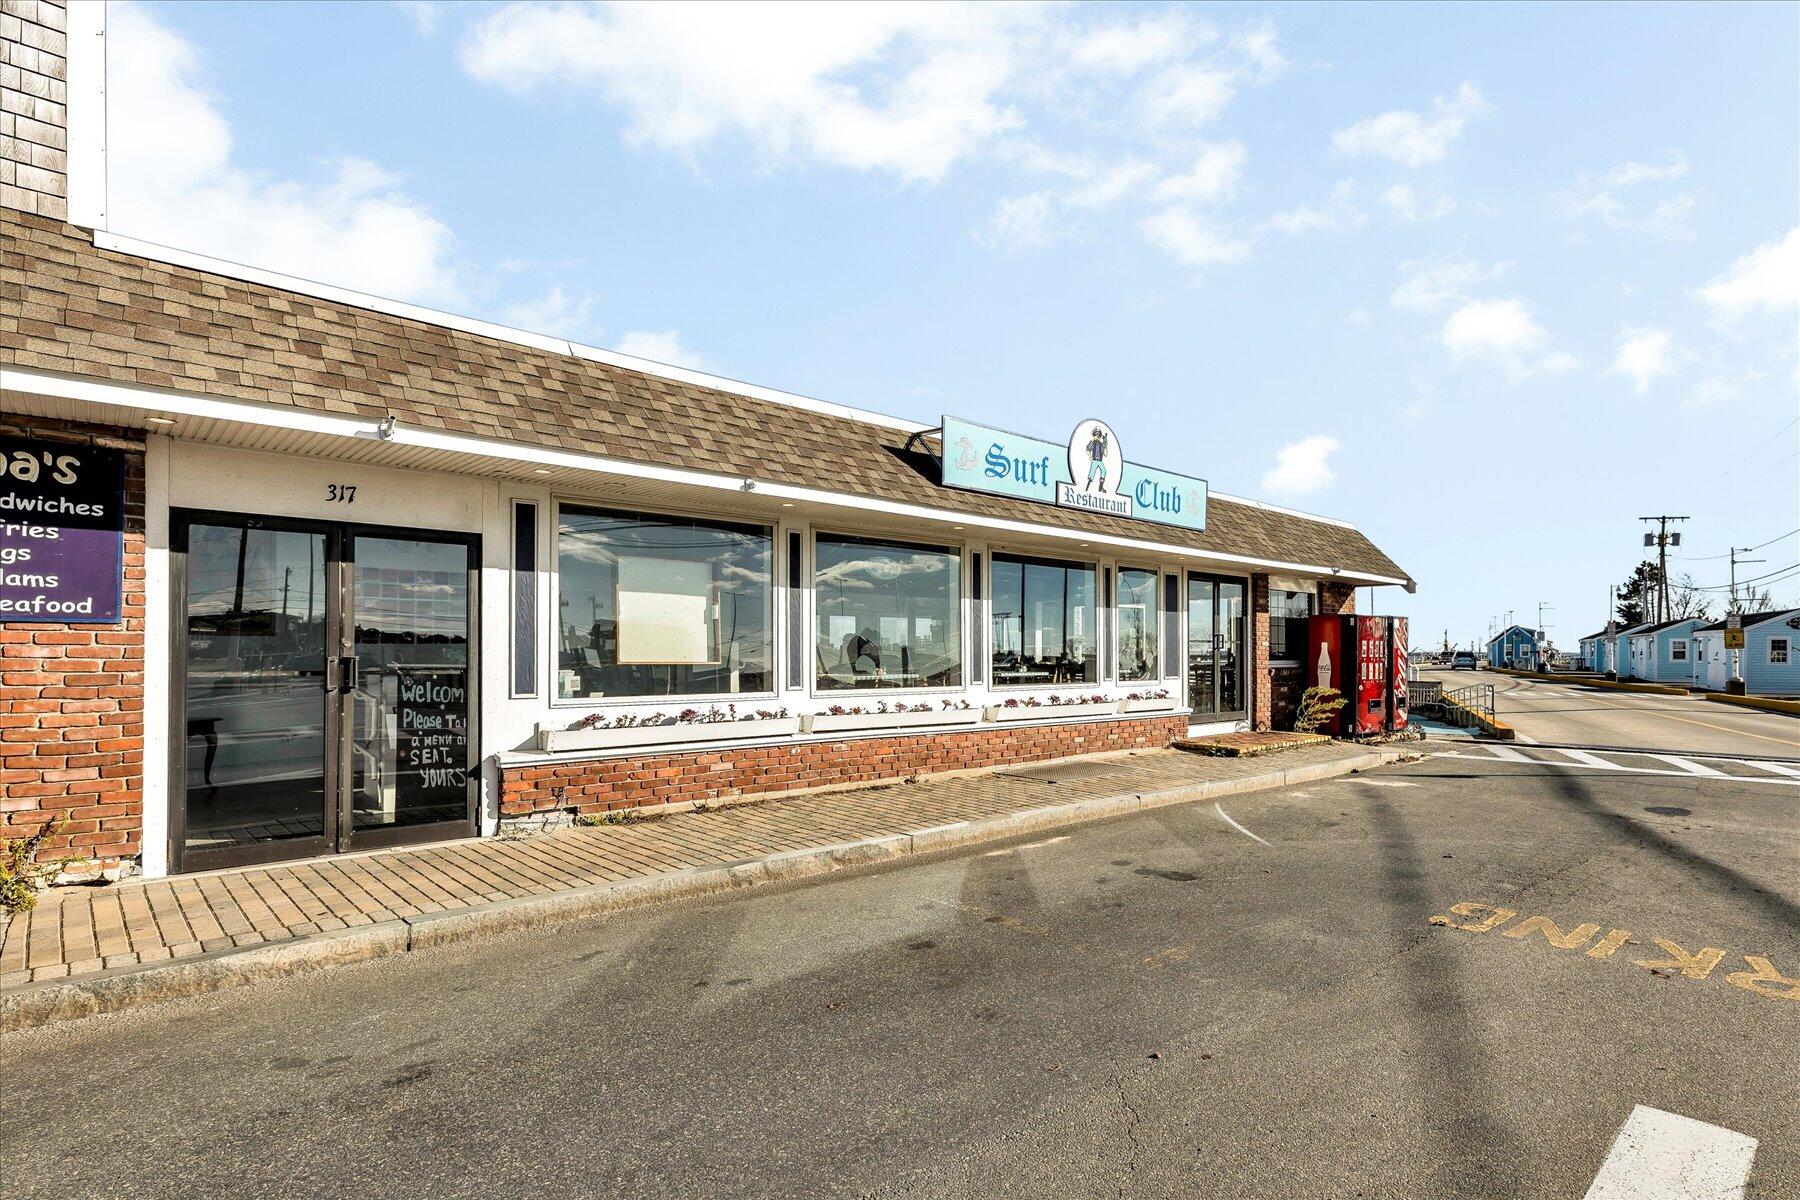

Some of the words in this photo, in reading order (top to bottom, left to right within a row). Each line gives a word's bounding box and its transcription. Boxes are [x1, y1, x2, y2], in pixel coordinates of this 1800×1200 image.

[984, 442, 1049, 488] Surf
[1135, 478, 1182, 515] Club
[325, 484, 357, 504] 317
[1063, 485, 1128, 514] Restaurant
[403, 708, 442, 729] Please
